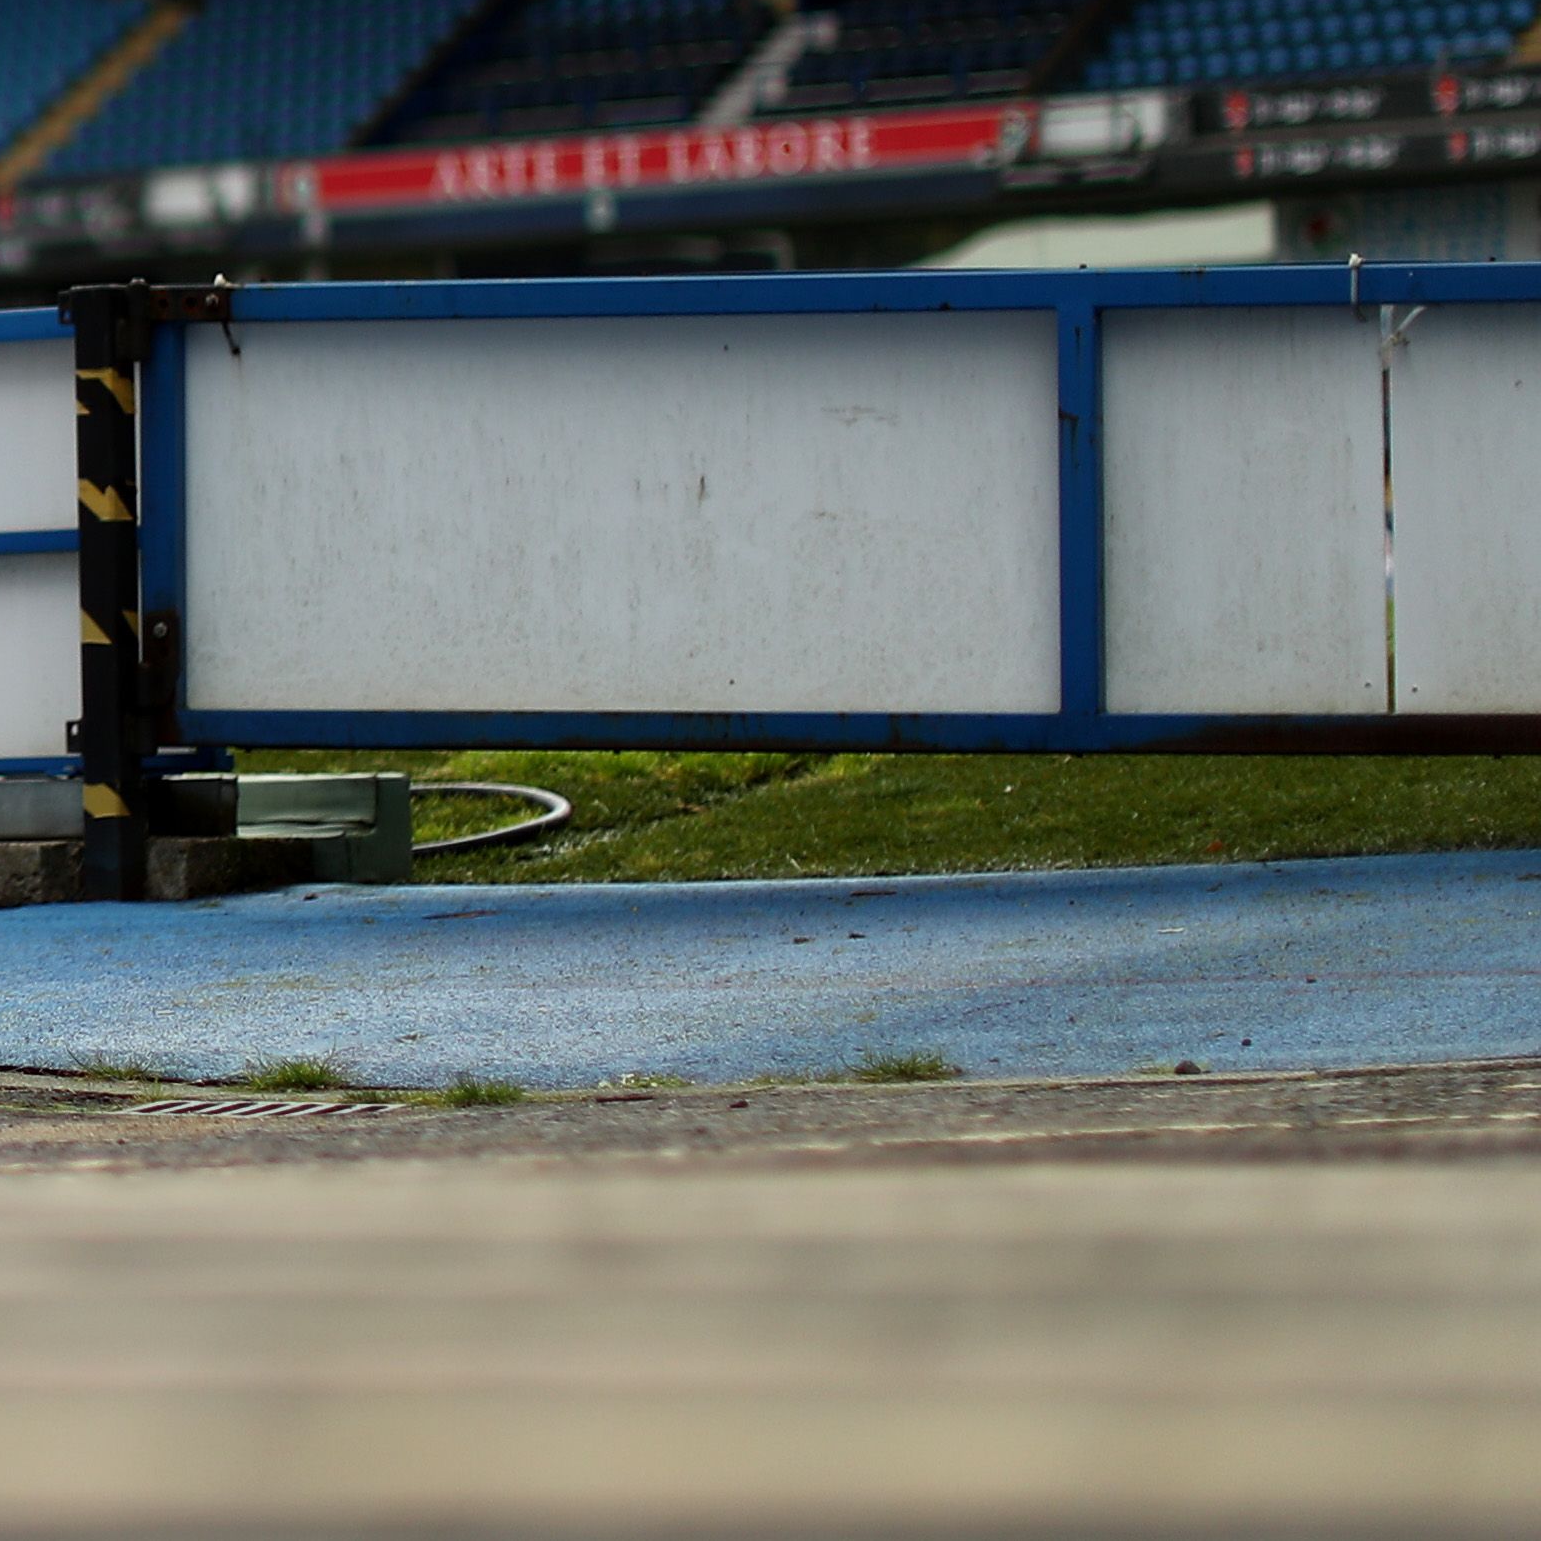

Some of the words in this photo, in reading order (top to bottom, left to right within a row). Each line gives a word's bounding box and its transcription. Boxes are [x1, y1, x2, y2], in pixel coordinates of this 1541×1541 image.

[432, 143, 558, 202] ARTE
[584, 138, 640, 191] ET
[668, 118, 878, 183] LABORE
